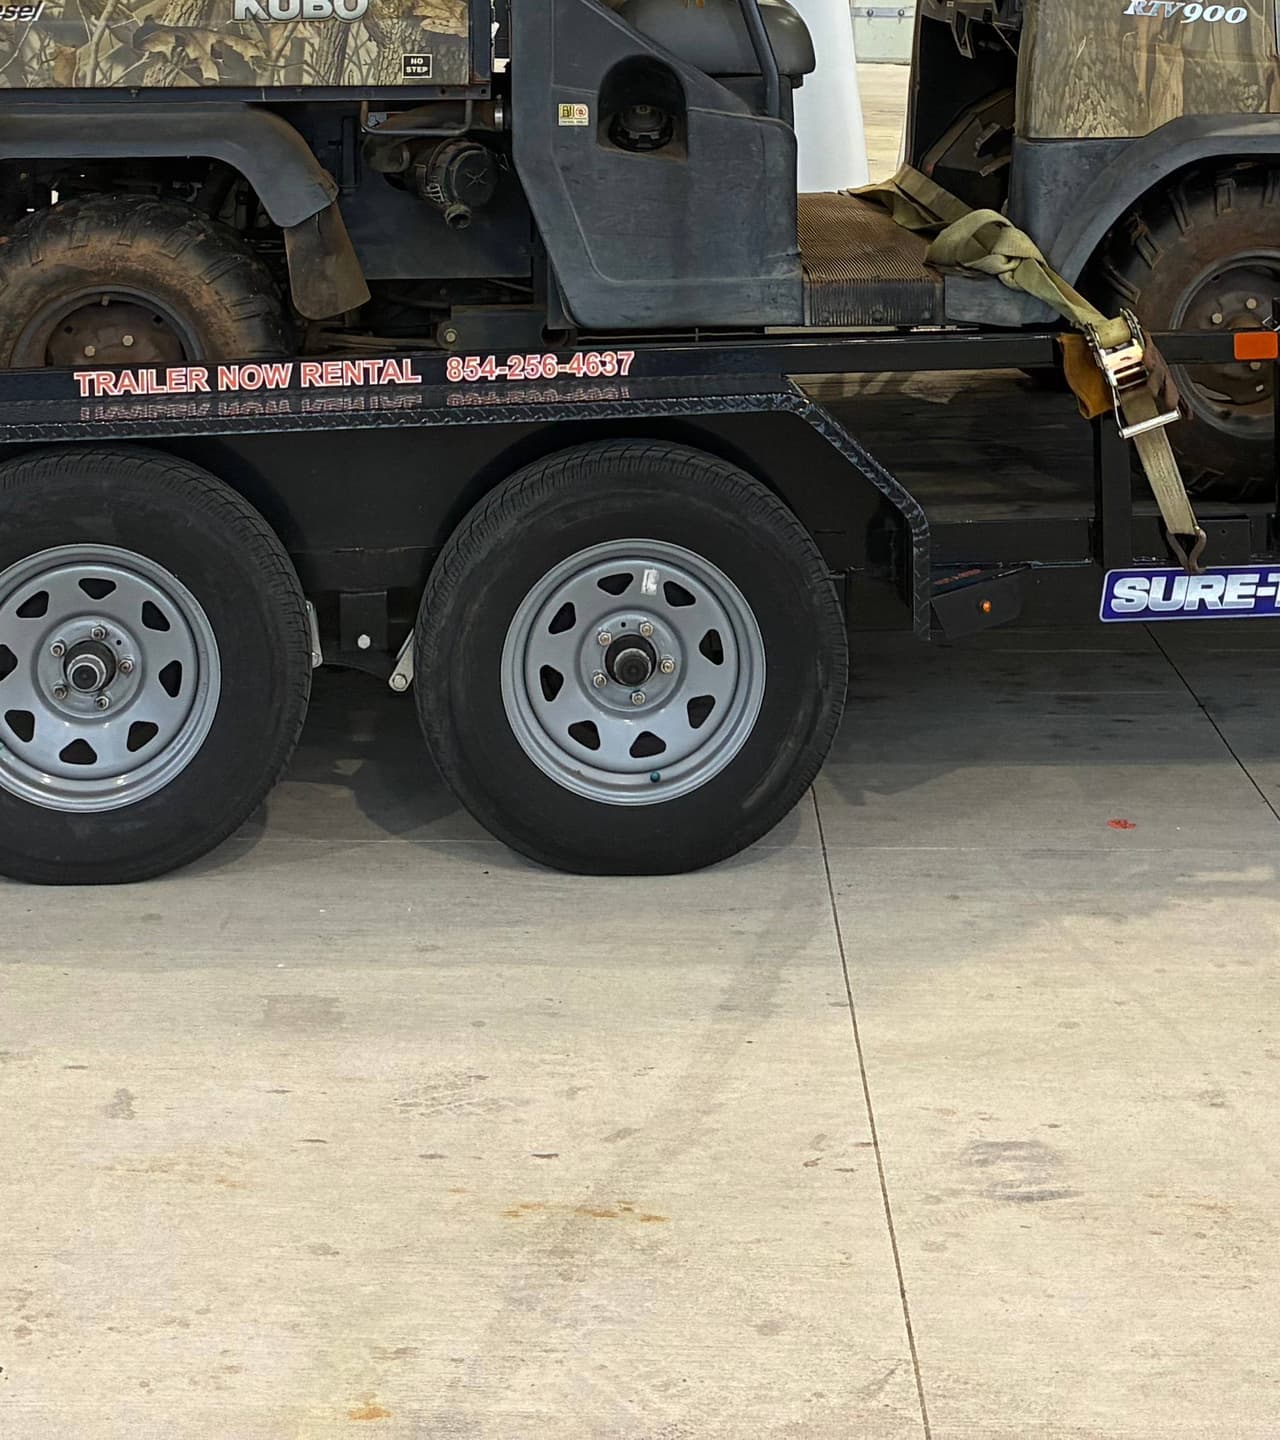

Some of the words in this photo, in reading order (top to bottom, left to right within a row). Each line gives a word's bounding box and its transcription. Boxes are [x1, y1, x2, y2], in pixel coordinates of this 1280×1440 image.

[74, 366, 210, 397] TRAILER
[217, 363, 294, 392] NOW
[300, 358, 422, 388] RENTAL
[447, 351, 635, 382] 854-256-4637
